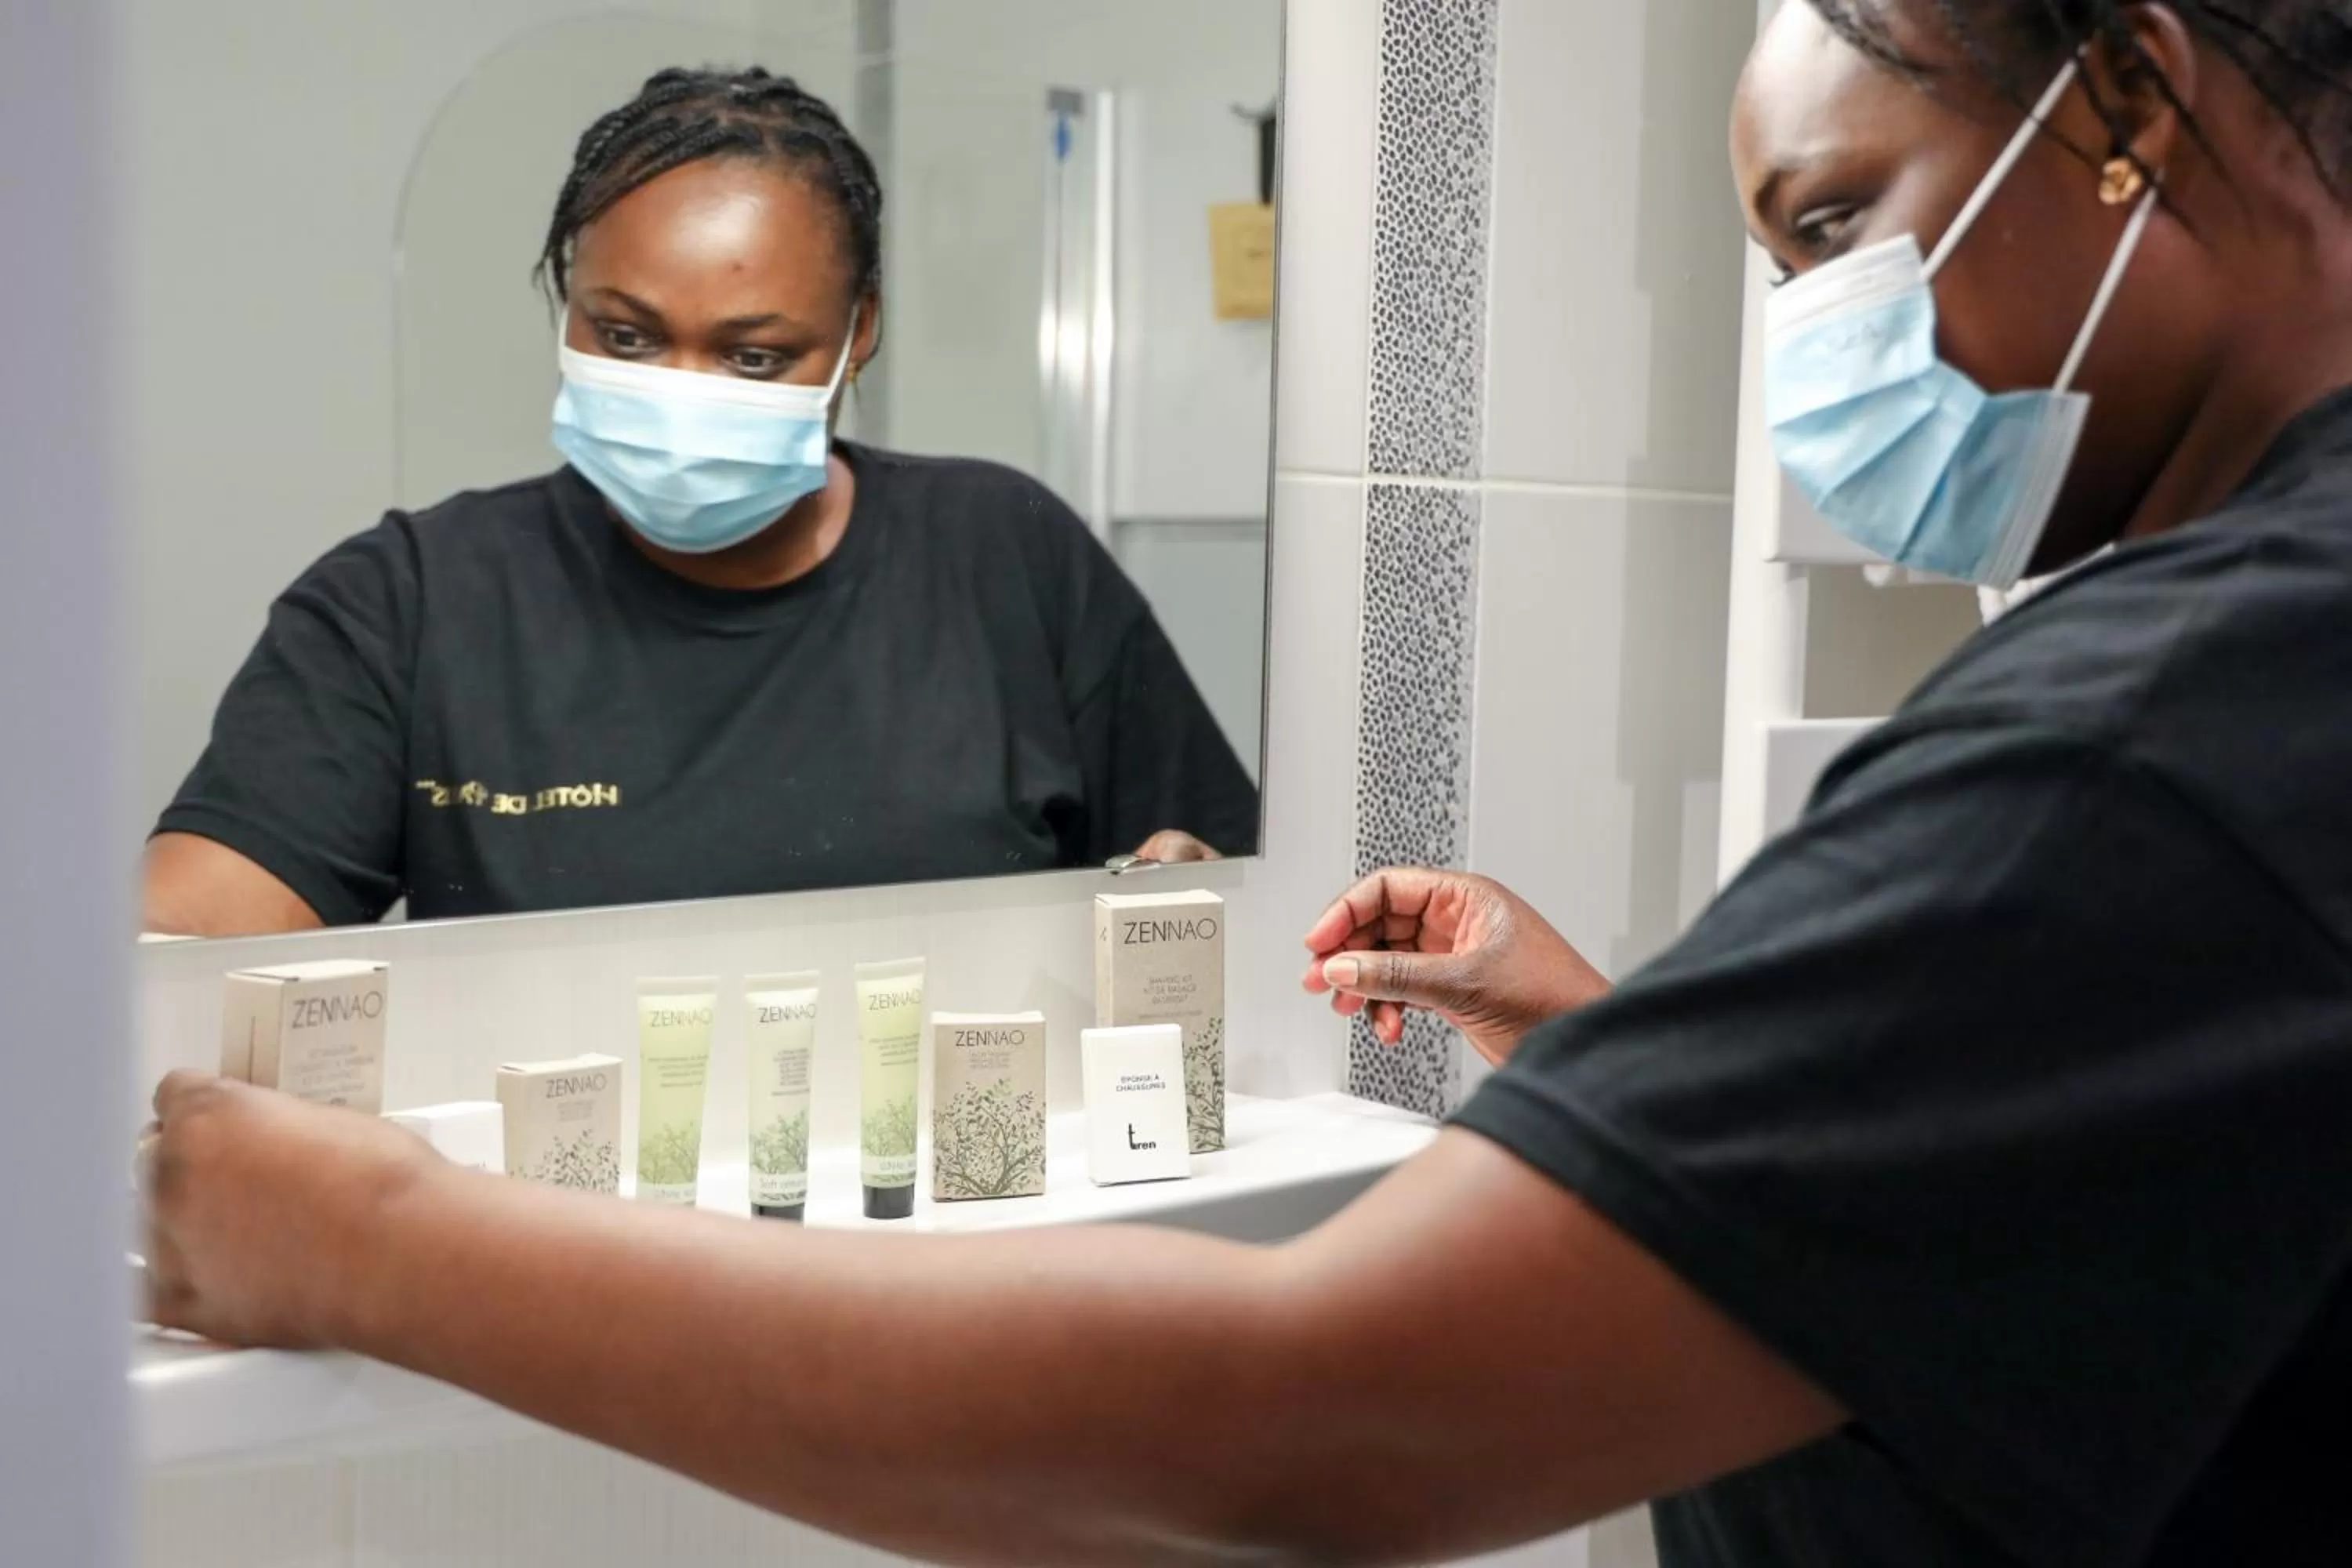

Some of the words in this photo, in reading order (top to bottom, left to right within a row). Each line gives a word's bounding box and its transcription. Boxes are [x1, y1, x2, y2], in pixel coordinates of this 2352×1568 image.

[1123, 917, 1217, 945] ZENNAO
[292, 990, 383, 1029] ZENNAO
[868, 989, 921, 1011] ZENNAO
[649, 1007, 714, 1027] ZENNAO
[757, 1004, 816, 1023] ZENNAO
[955, 1029, 1025, 1047] ZENNAO
[546, 1073, 608, 1098] ZENNAO
